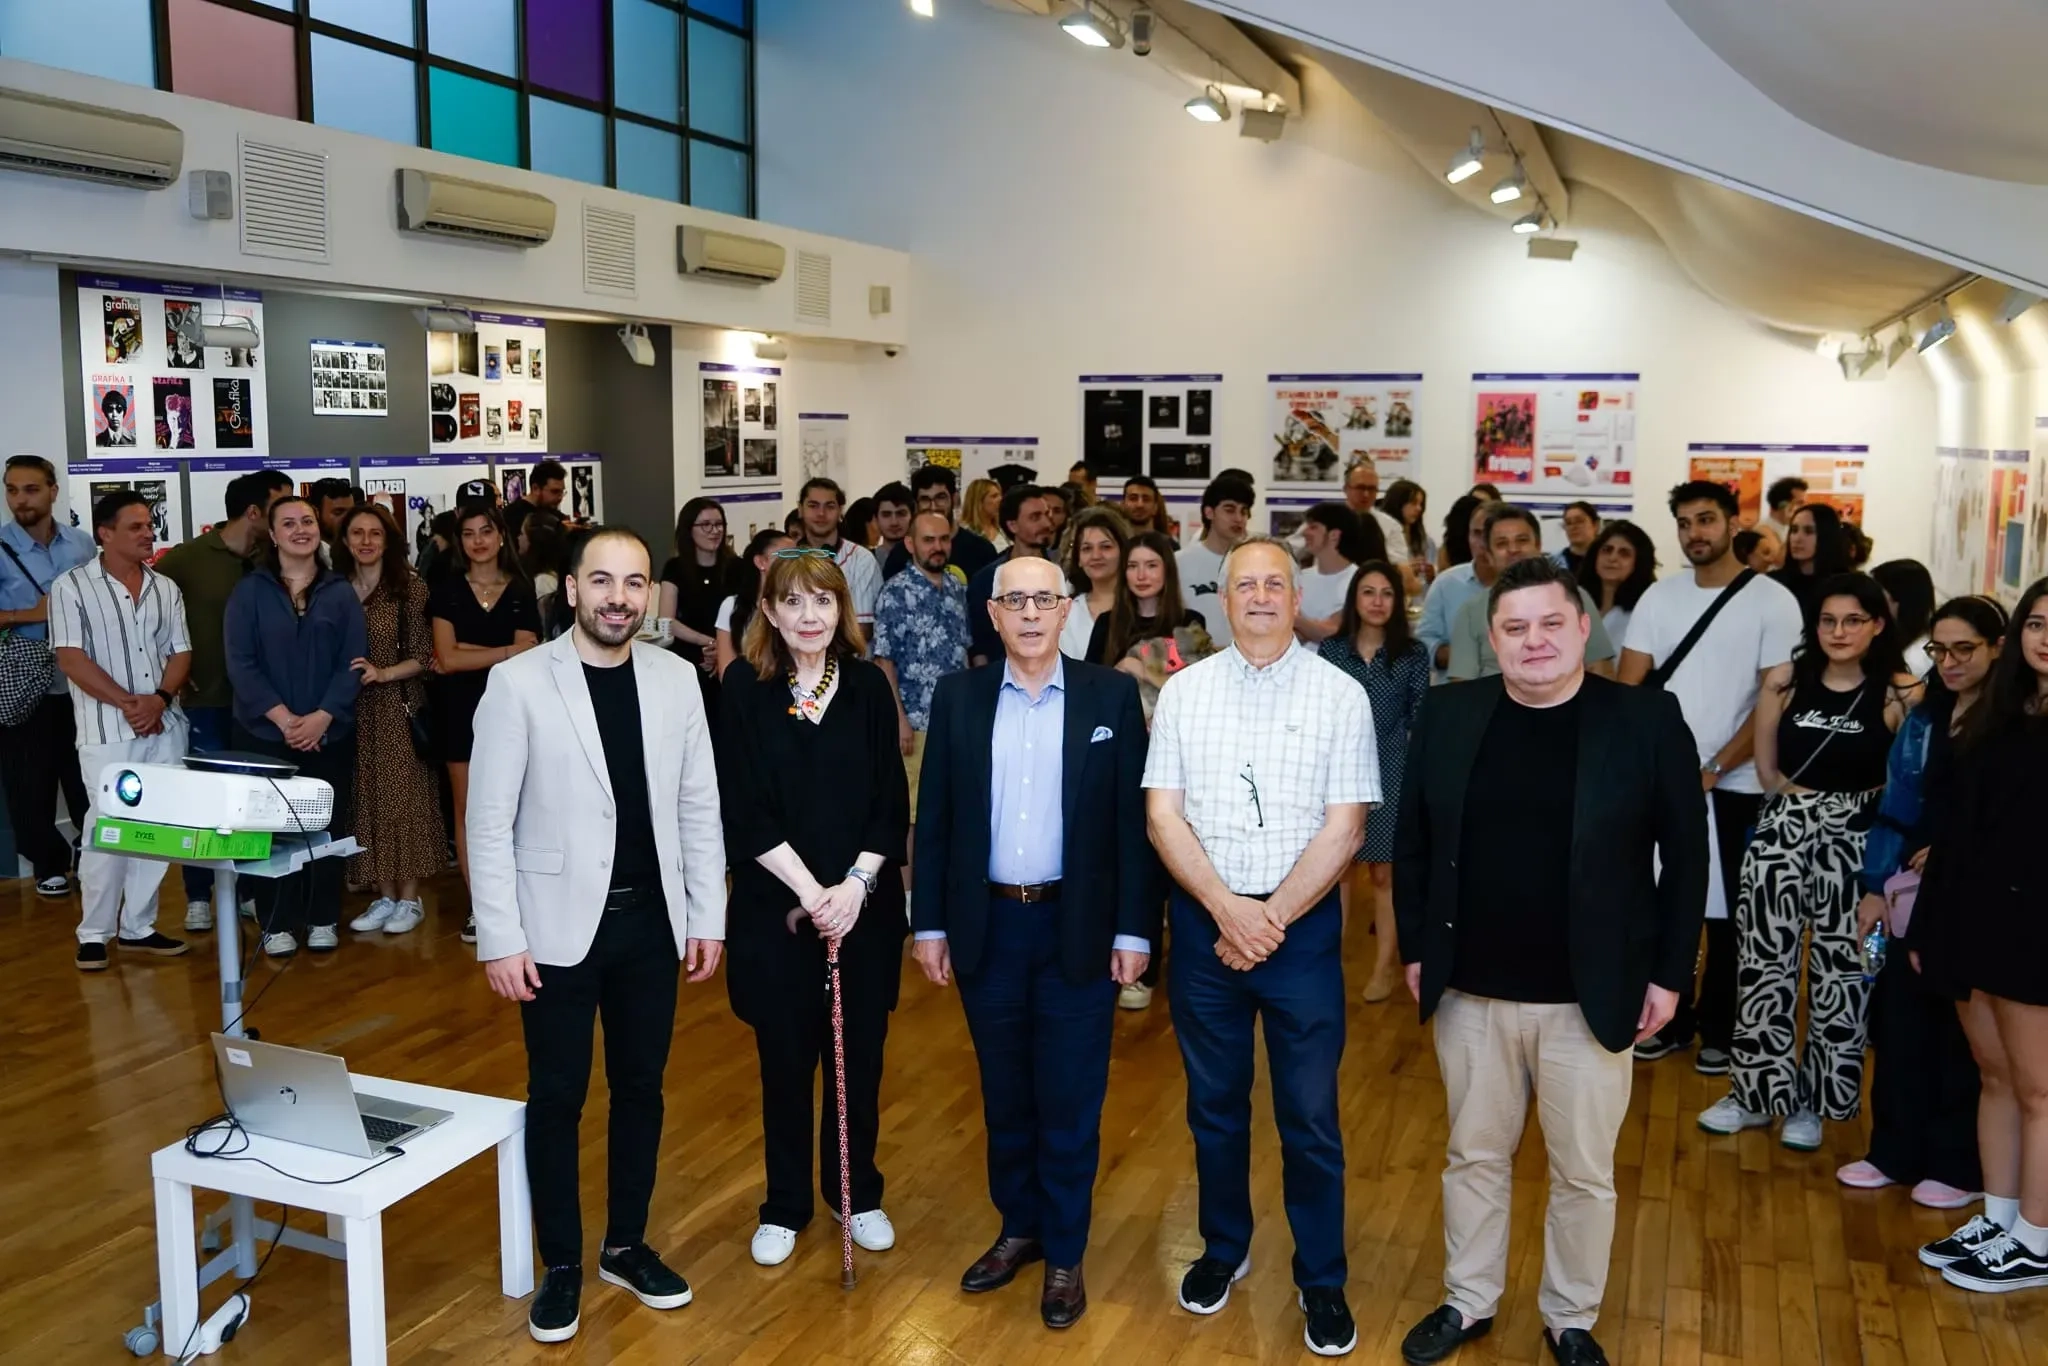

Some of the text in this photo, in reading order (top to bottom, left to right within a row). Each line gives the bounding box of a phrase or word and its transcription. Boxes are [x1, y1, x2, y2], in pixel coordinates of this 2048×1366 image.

[105, 298, 139, 311] grafika
[409, 497, 425, 510] GQ
[1793, 710, 1828, 725] New
